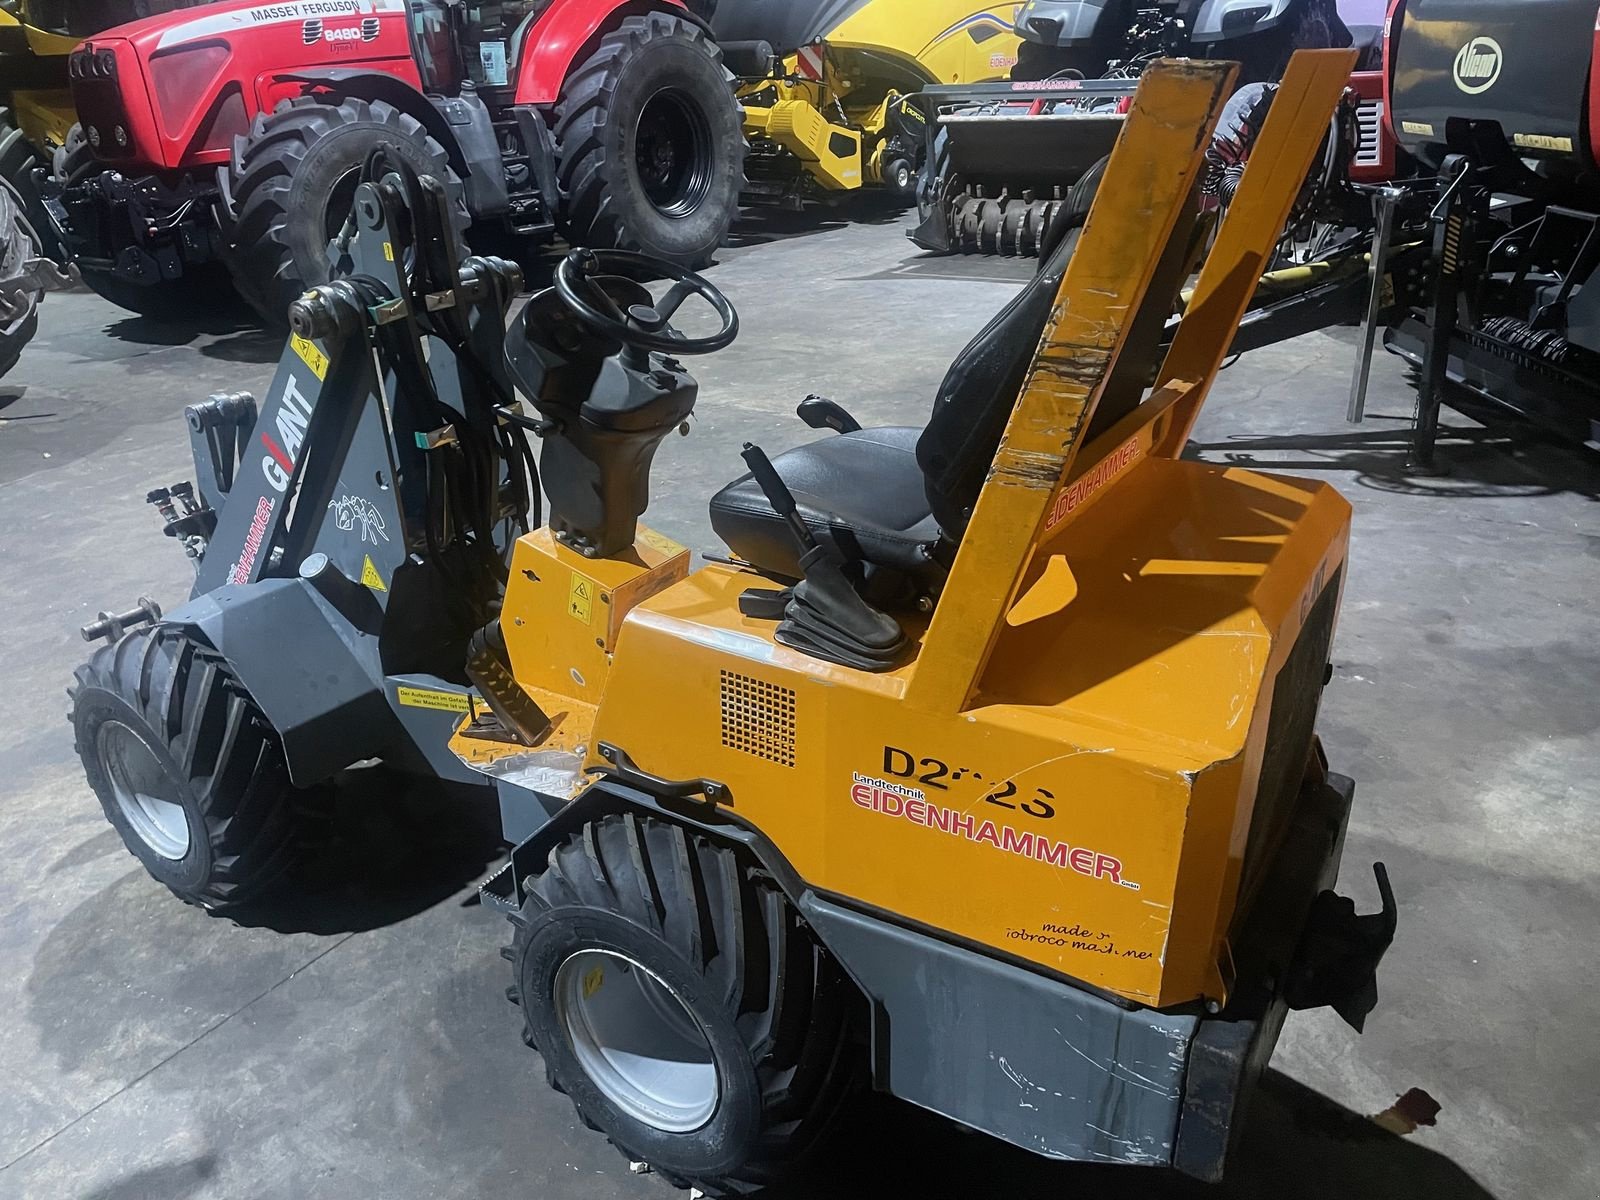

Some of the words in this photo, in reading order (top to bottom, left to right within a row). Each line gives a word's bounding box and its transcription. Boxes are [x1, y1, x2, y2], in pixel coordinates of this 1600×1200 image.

[250, 5, 299, 22] MASSEY
[303, 0, 361, 15] FERGUSON
[261, 373, 313, 492] GIANT
[853, 771, 926, 801] Landtechnik
[850, 783, 1122, 884] EIDENHAMMER
[1041, 922, 1093, 939] made
